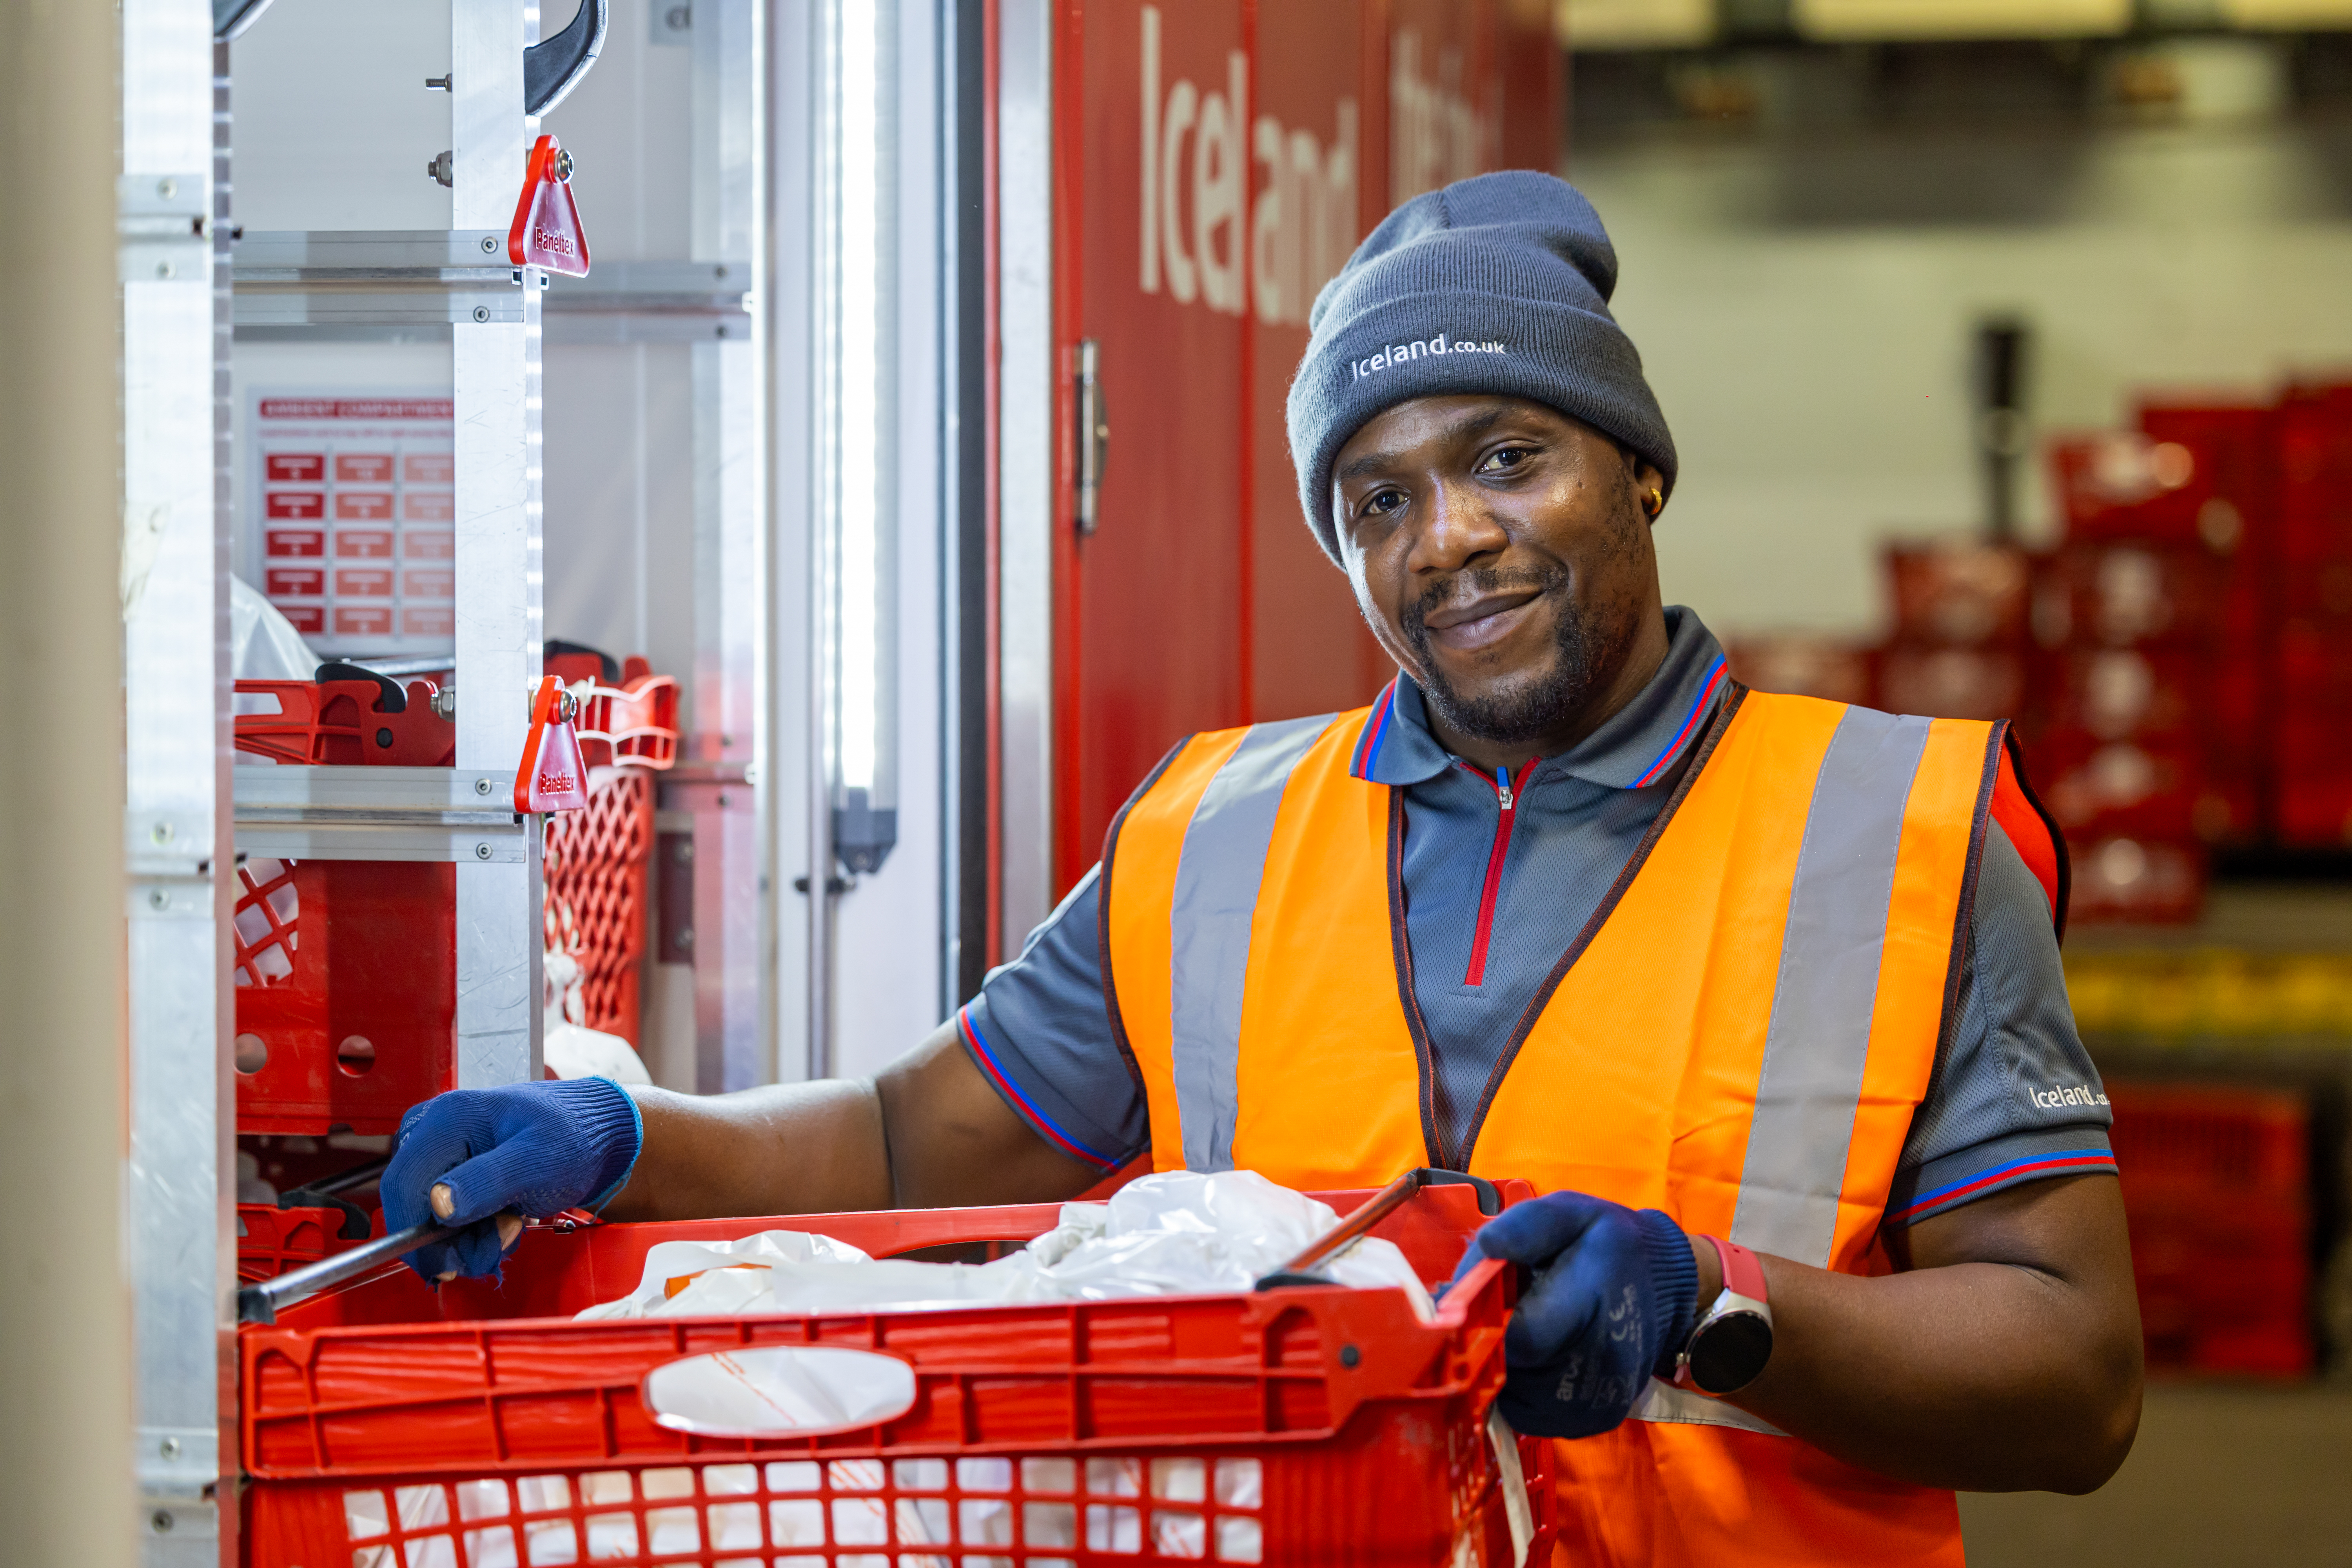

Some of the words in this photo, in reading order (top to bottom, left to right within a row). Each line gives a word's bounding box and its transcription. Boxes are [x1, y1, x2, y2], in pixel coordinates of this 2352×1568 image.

[1139, 3, 1359, 327] Iceland
[535, 227, 575, 257] Paneltex
[1352, 333, 1506, 381] Iceland.co.uk
